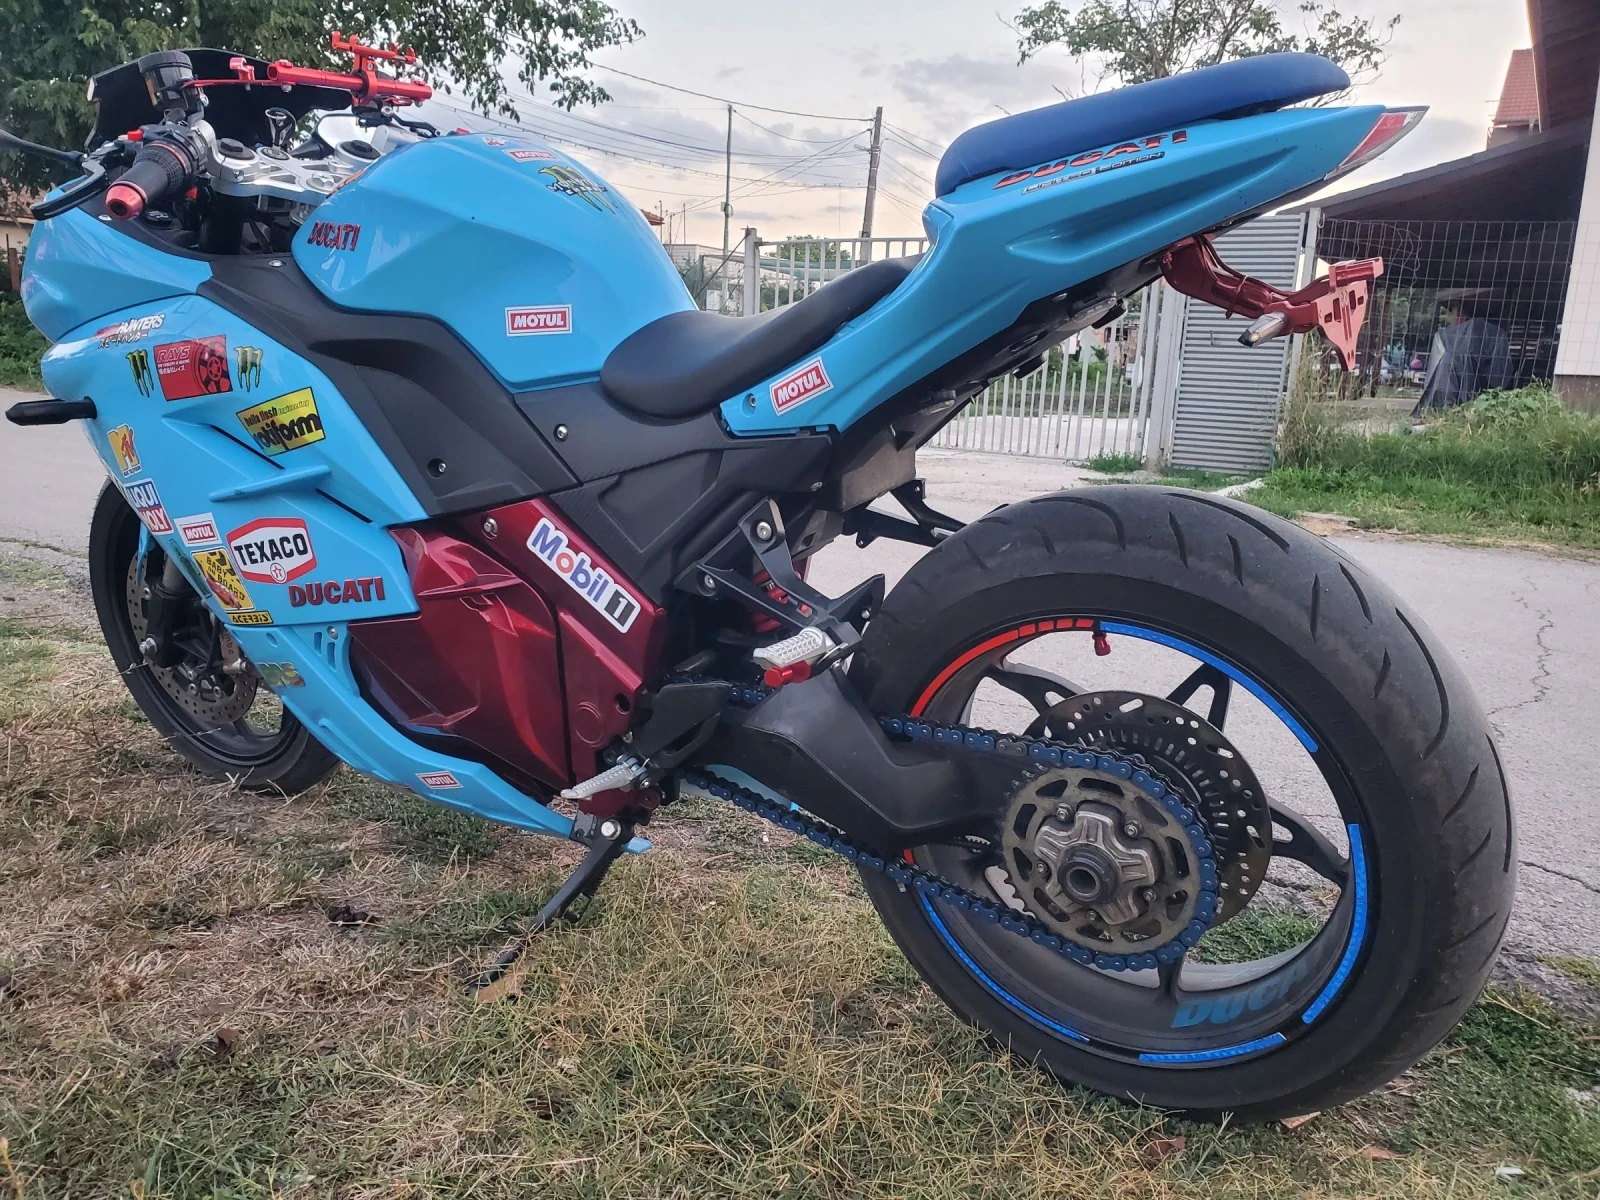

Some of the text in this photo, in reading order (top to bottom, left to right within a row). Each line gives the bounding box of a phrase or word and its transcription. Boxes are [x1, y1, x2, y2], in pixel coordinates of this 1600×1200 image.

[993, 130, 1188, 190] DUCATI
[1098, 151, 1165, 174] EDITION
[307, 220, 361, 251] DUCATI
[115, 314, 165, 334] HUNTERS
[513, 313, 565, 329] MOTUL
[157, 345, 190, 363] RAYS
[777, 370, 821, 405] MOTUL
[185, 526, 214, 540] MOTUL
[233, 533, 309, 566] TEXACO
[206, 555, 228, 578] BABY
[531, 523, 610, 603] Mobil
[217, 573, 245, 601] BOARD
[288, 576, 385, 607] DUCATI
[424, 775, 456, 786] MOTUL
